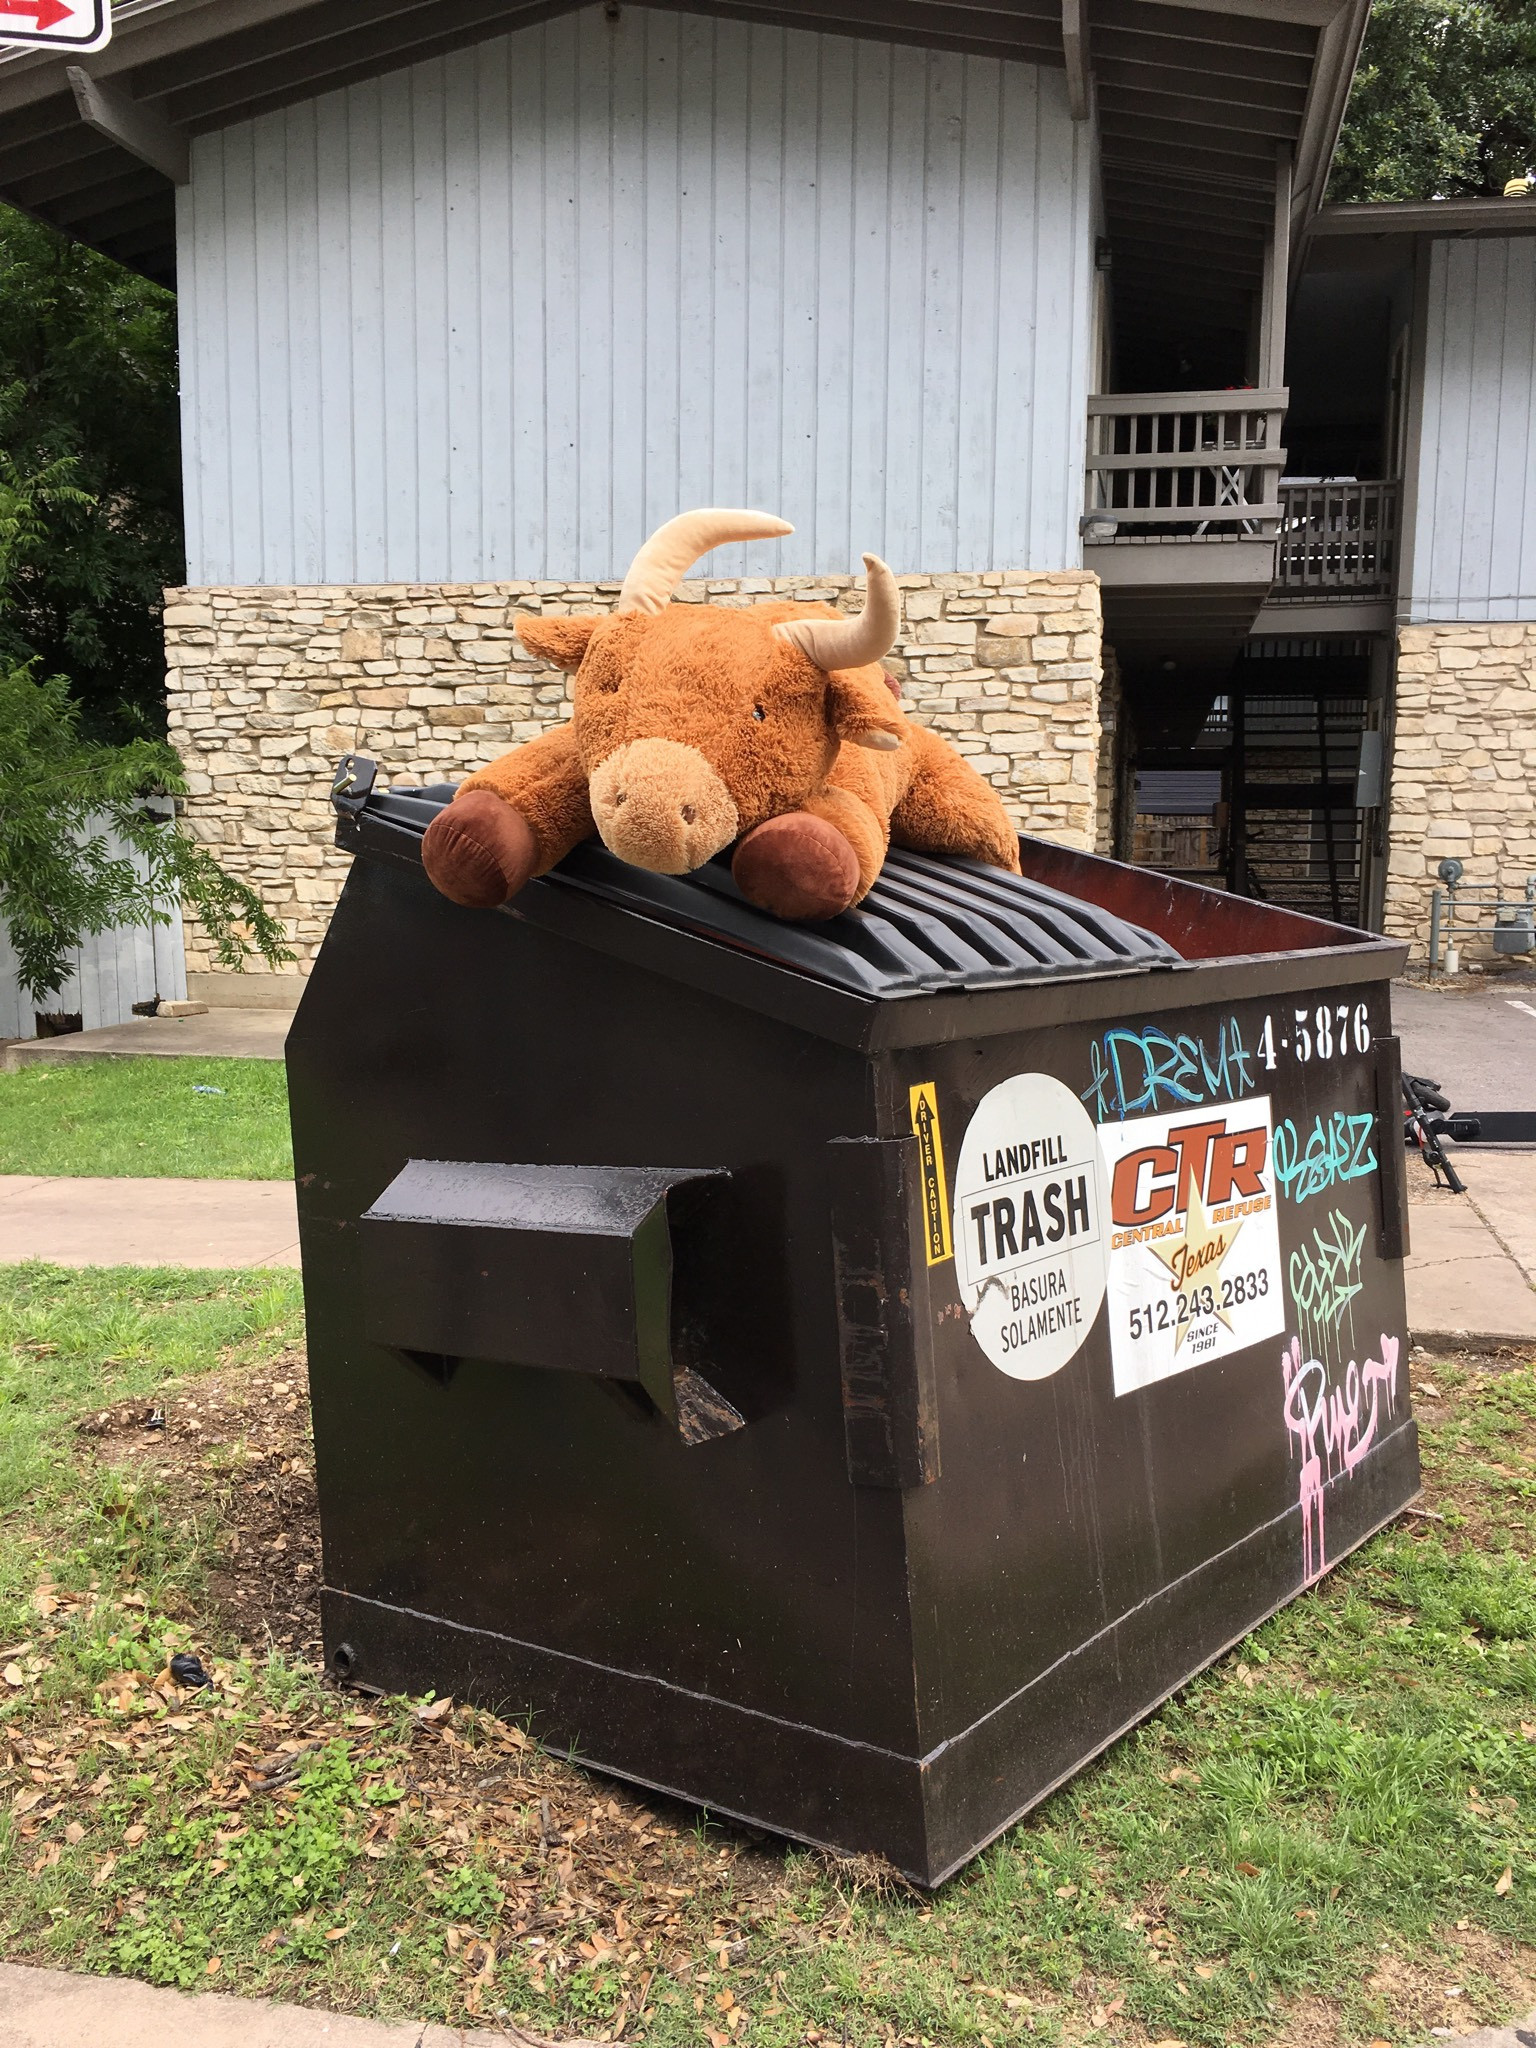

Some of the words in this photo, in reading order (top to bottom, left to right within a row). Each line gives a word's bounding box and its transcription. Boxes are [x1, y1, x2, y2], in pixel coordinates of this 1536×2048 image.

[919, 1100, 933, 1166] DRIVER
[928, 1177, 941, 1255] CAUTION
[983, 1135, 1067, 1182] LANDFILL
[1111, 1118, 1267, 1227] CTR
[970, 1175, 1091, 1266] TRASH
[1111, 1218, 1183, 1250] CENTRAL
[1212, 1195, 1272, 1224] REFUSE
[1010, 1268, 1067, 1312] BASURA
[1170, 1234, 1226, 1292] Texas
[1000, 1297, 1082, 1353] SOLAMENTE
[1129, 1268, 1269, 1340] 512.243.2833
[1186, 1322, 1219, 1343] SINCE
[1192, 1336, 1216, 1354] 1981
